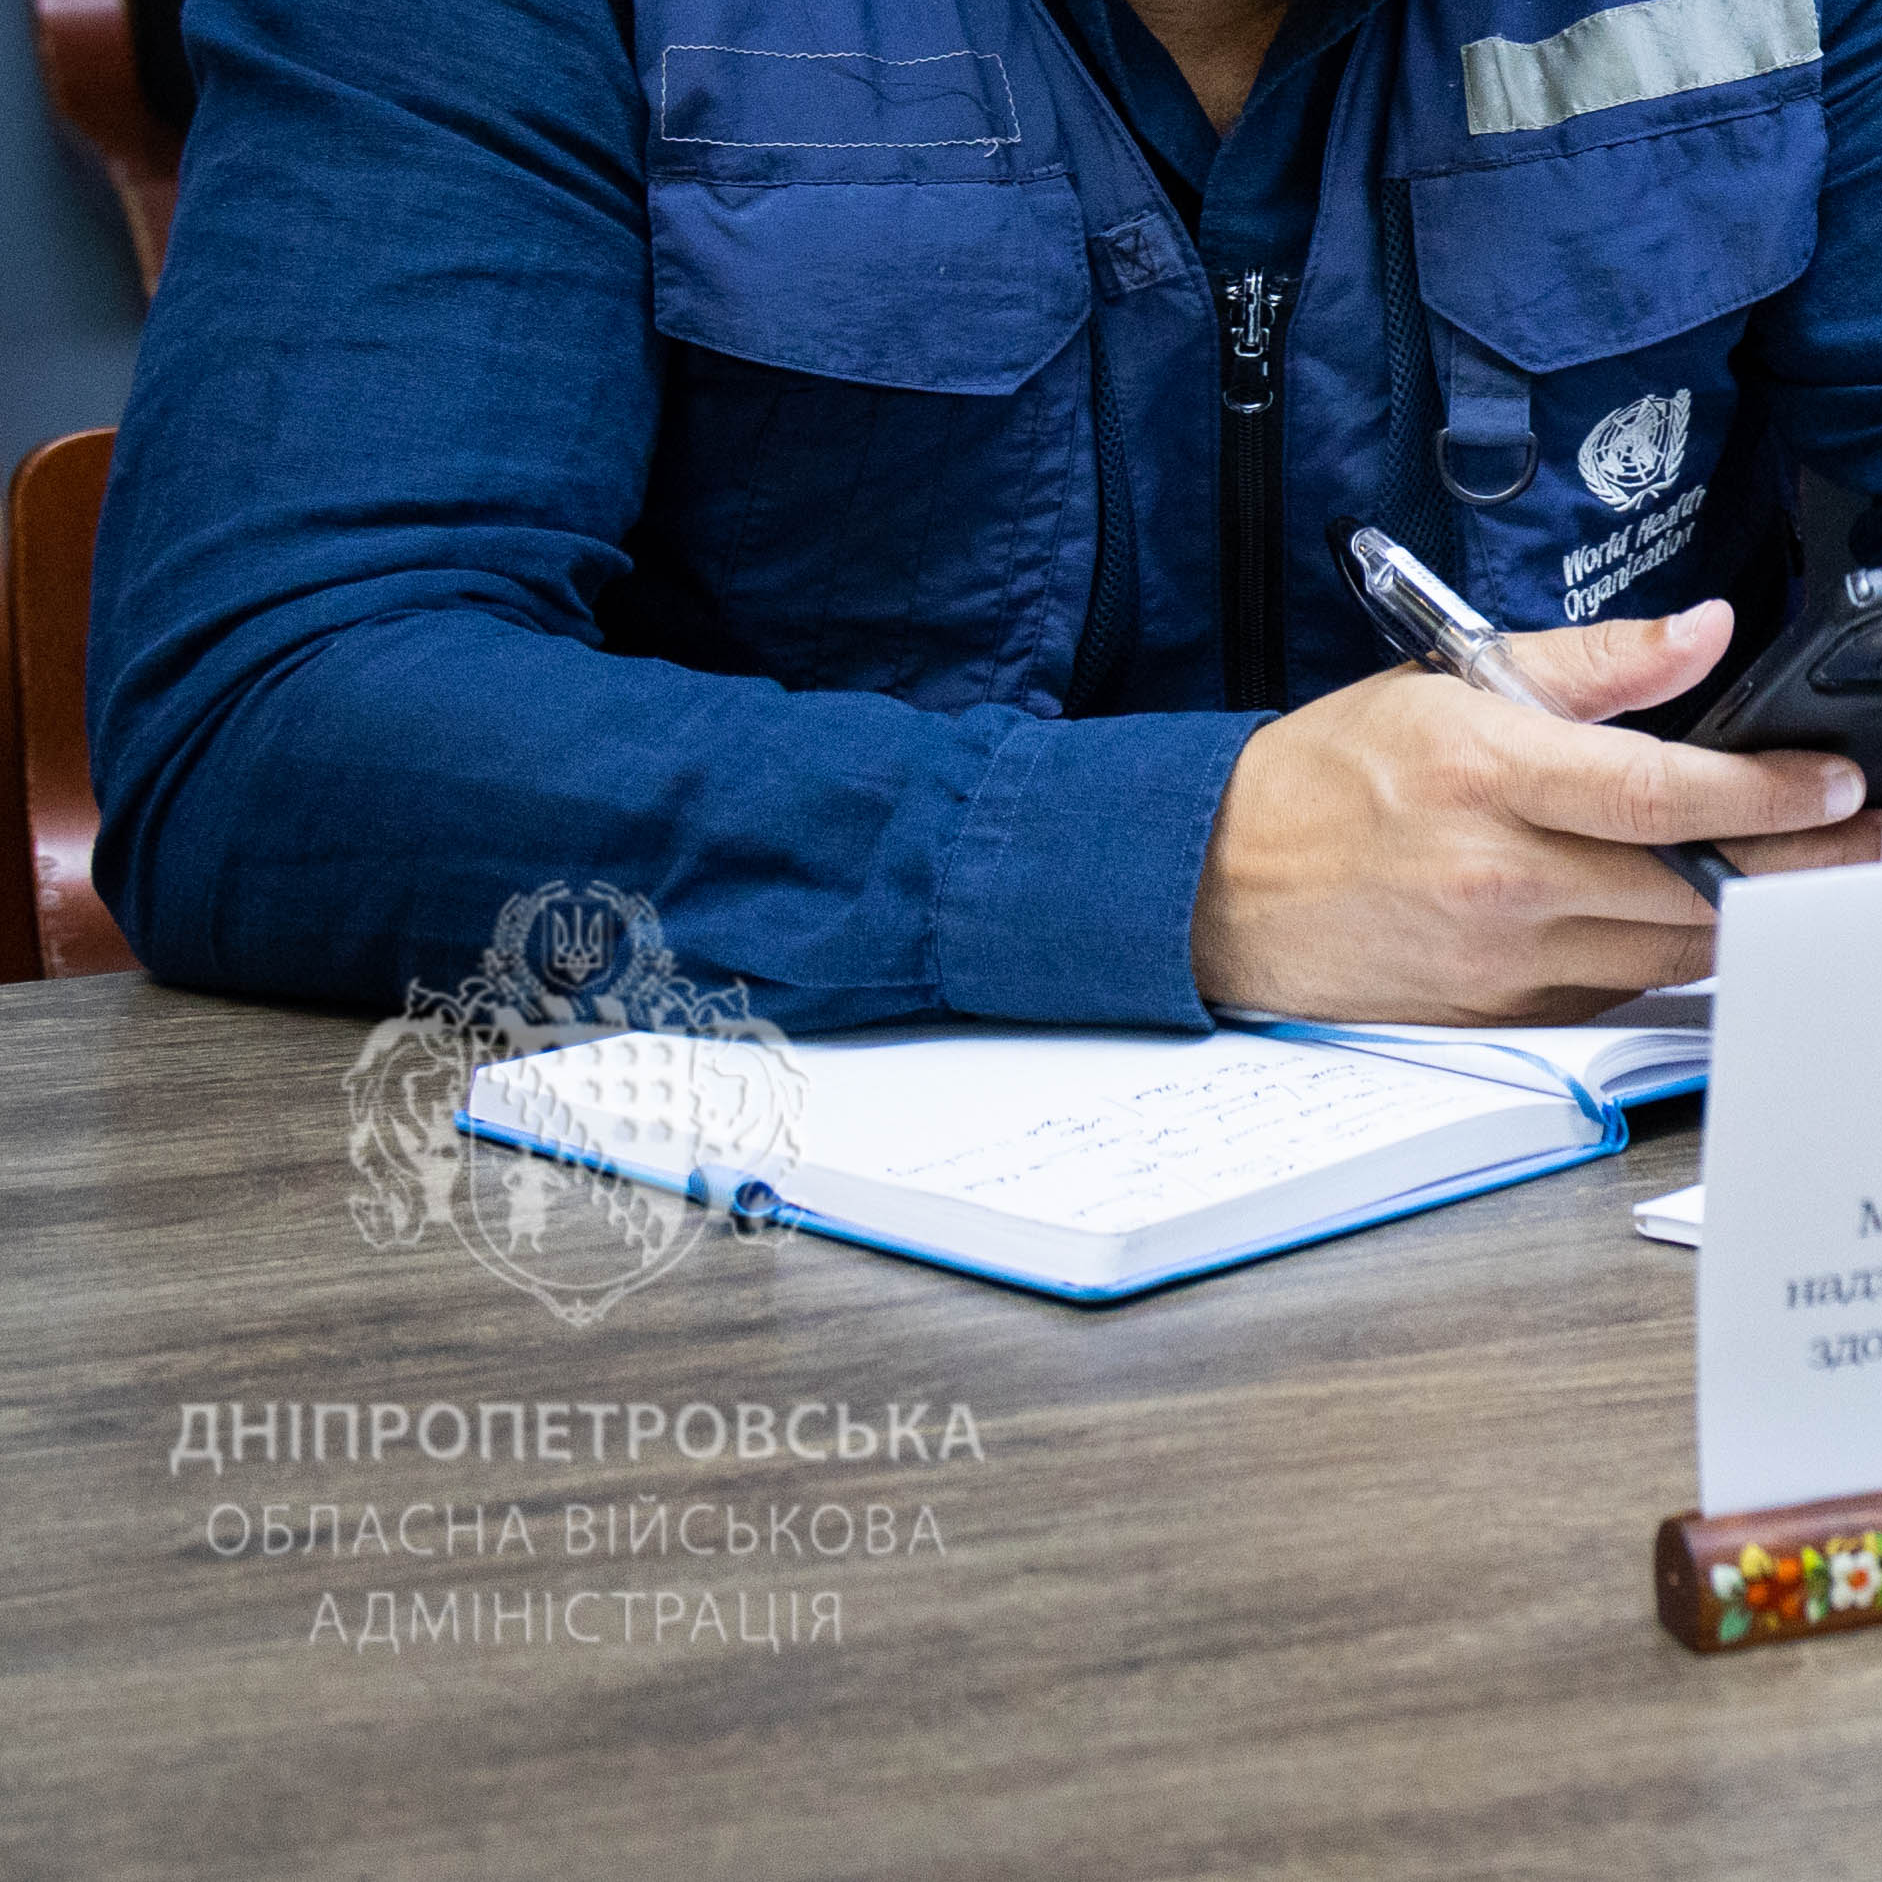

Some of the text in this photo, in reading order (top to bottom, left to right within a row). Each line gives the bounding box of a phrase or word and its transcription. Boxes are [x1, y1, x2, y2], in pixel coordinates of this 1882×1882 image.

[1562, 484, 1707, 587] World Health
[1563, 521, 1697, 622] Organization
